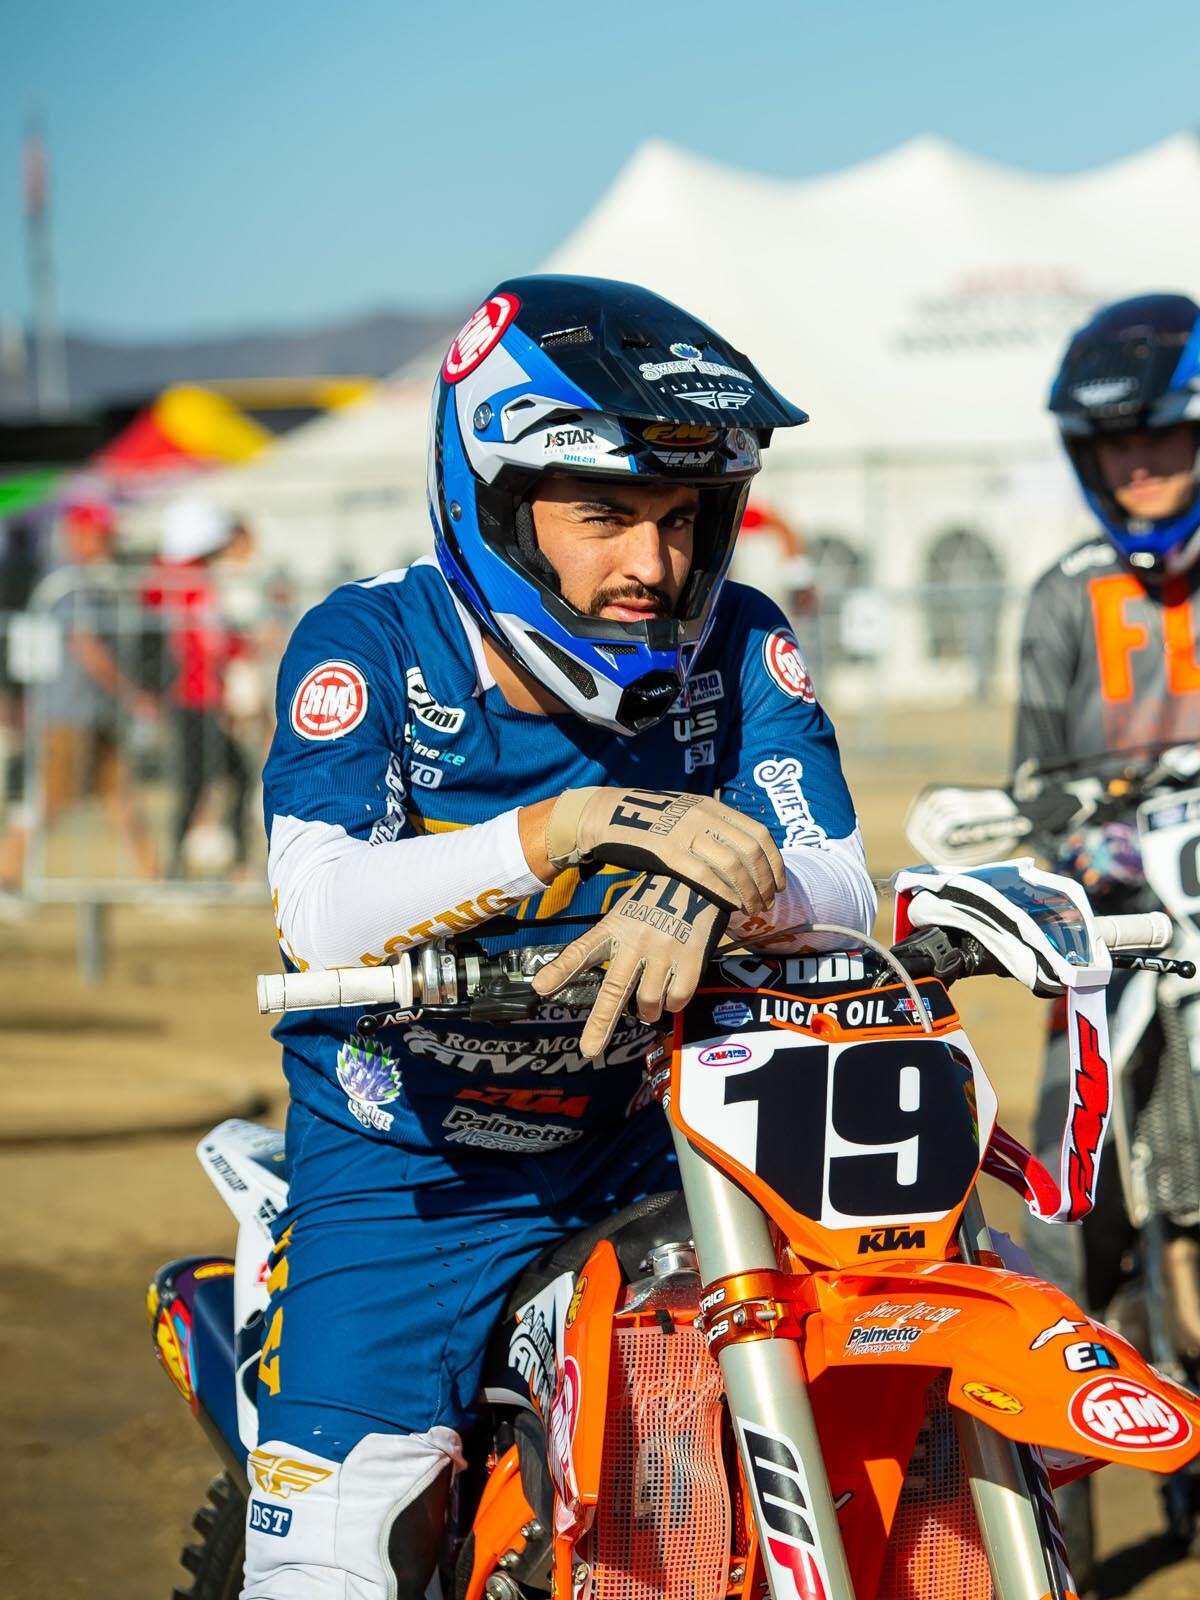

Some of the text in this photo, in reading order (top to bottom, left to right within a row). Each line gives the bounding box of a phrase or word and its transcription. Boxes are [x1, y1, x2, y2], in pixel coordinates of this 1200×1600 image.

[619, 900, 693, 945] RACING
[1132, 957, 1174, 972] ASV
[382, 1009, 424, 1026] ASV
[724, 1039, 981, 1222] 19
[857, 1225, 926, 1254] KTM
[846, 1326, 923, 1348] Palmetto
[963, 1382, 1023, 1414] FMF
[250, 1503, 289, 1535] DST
